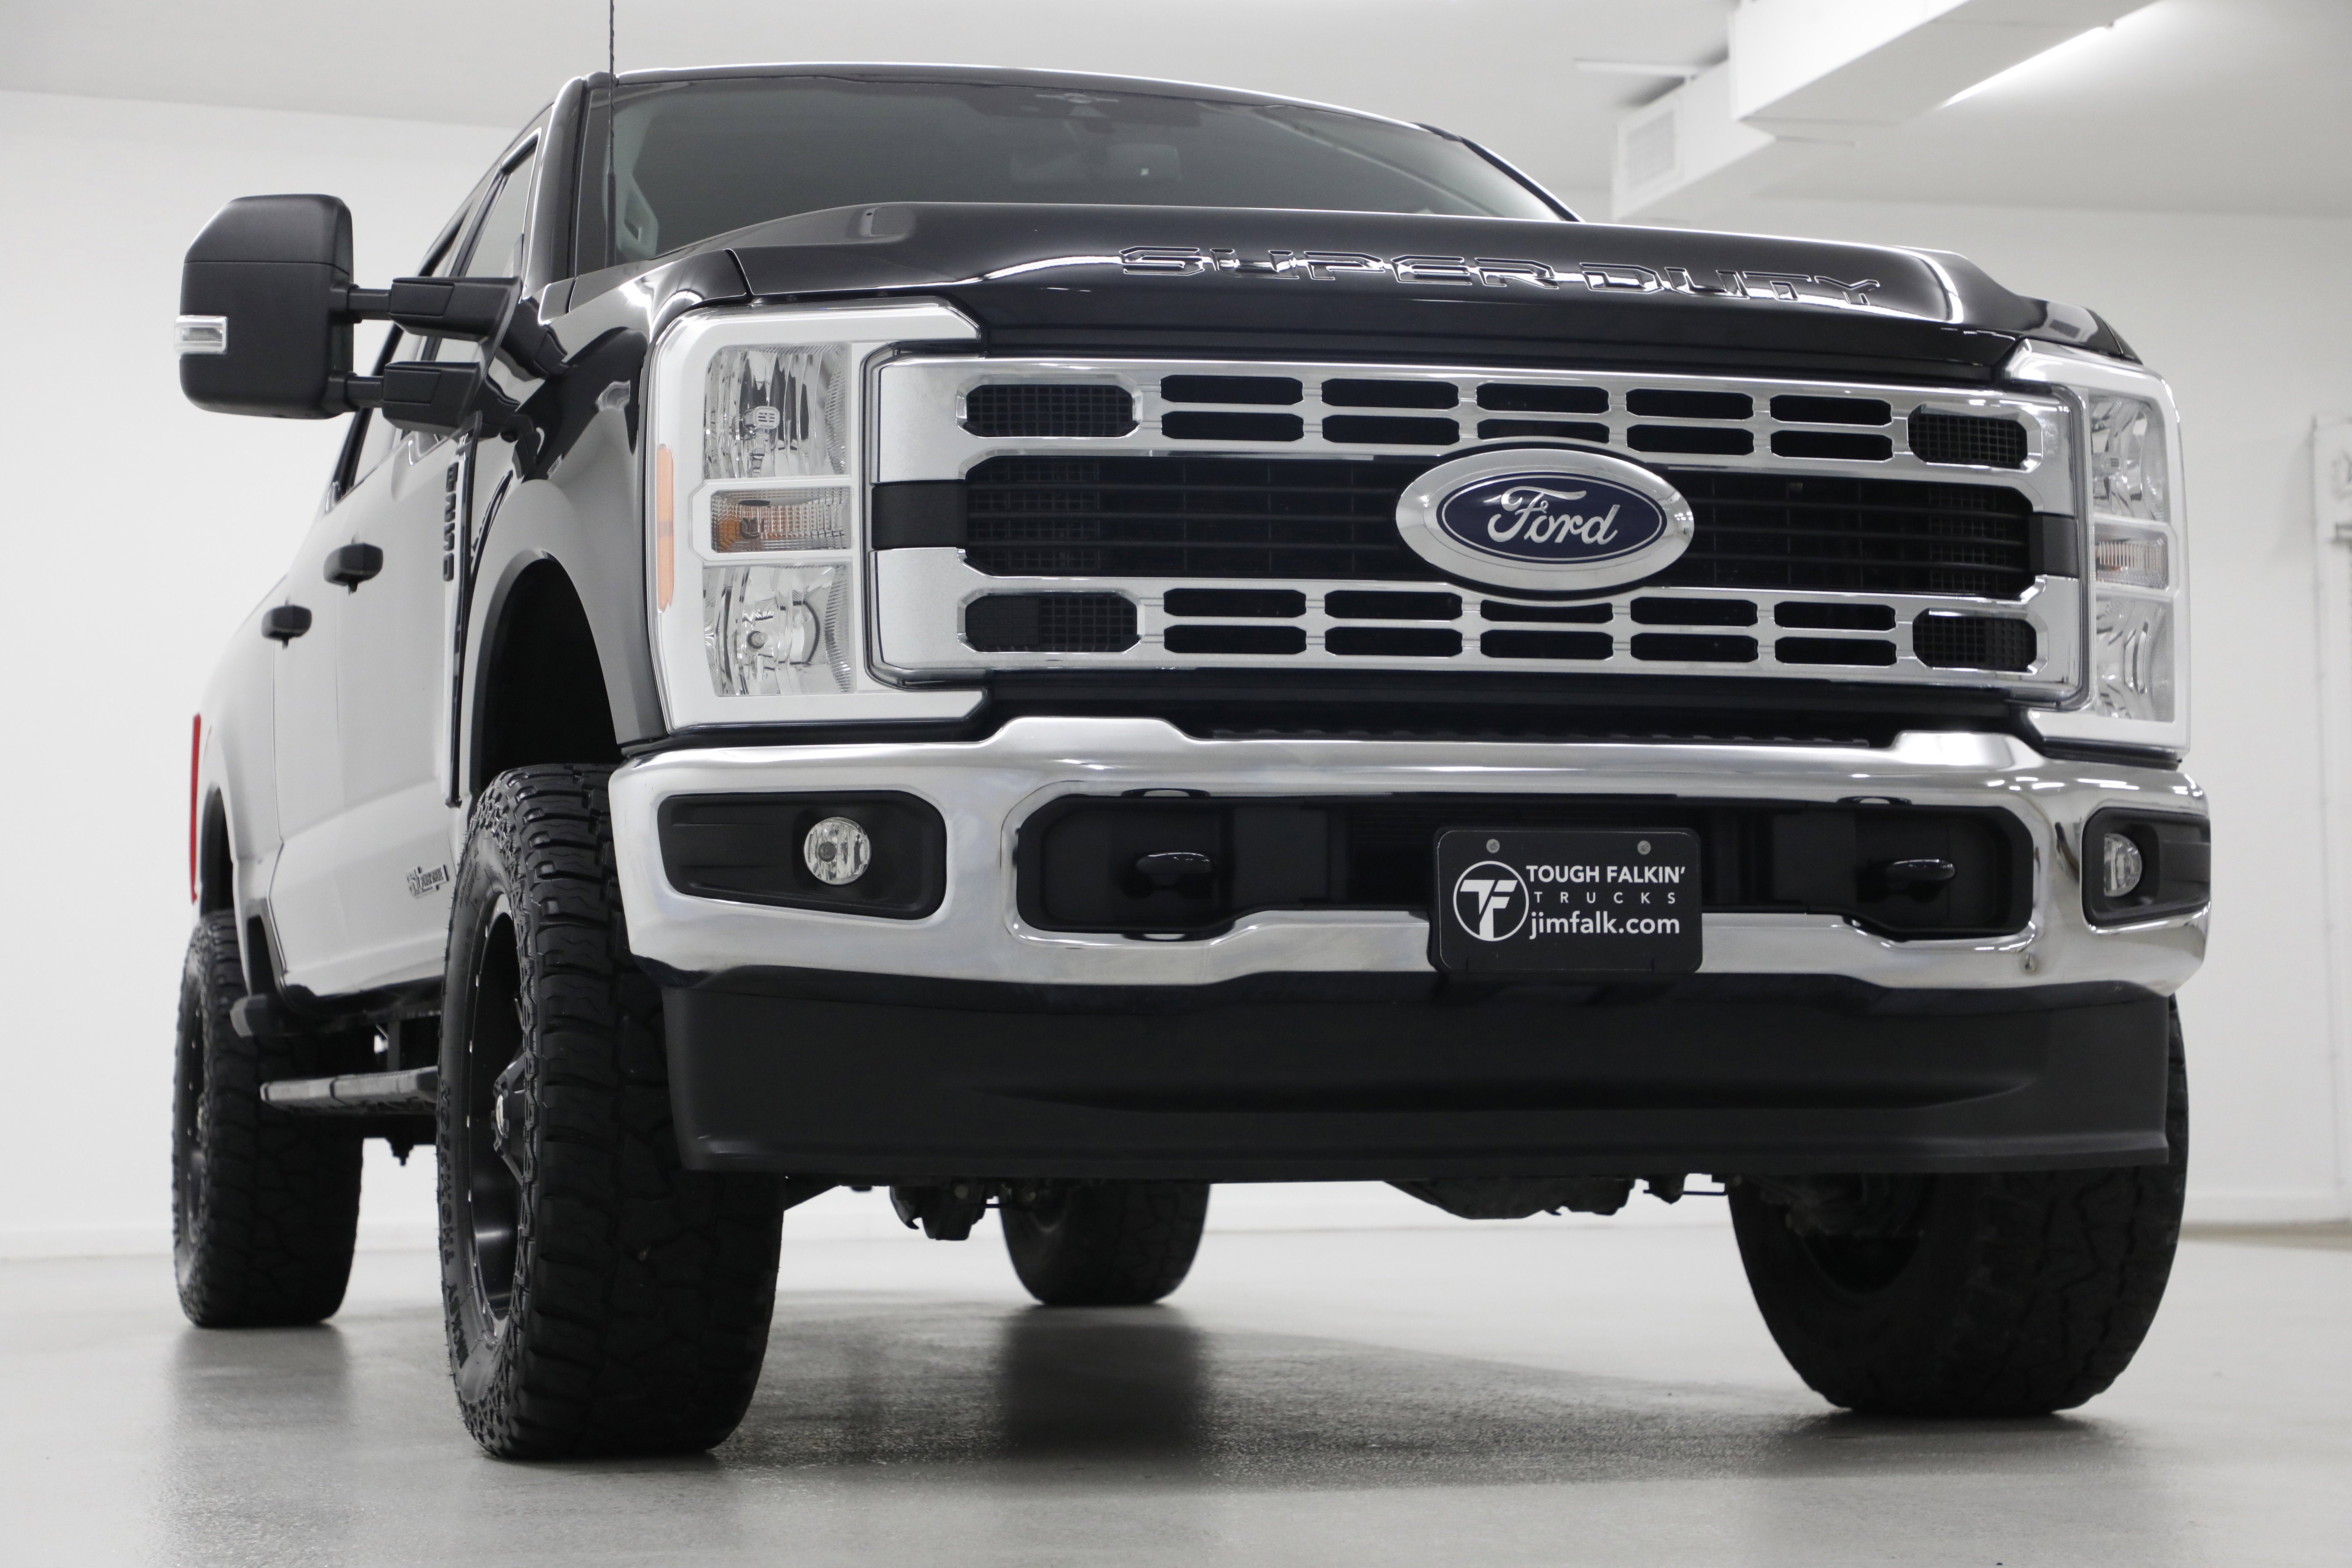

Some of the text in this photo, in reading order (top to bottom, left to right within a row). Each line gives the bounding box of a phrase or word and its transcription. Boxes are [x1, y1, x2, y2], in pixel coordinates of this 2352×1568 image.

[1119, 246, 1880, 305] SUPER DUTY
[1488, 486, 1620, 545] Ford
[1526, 865, 1599, 883] TOUGH
[1534, 891, 1675, 904] TRUCKS
[1529, 911, 1680, 939] jimfalk.com
